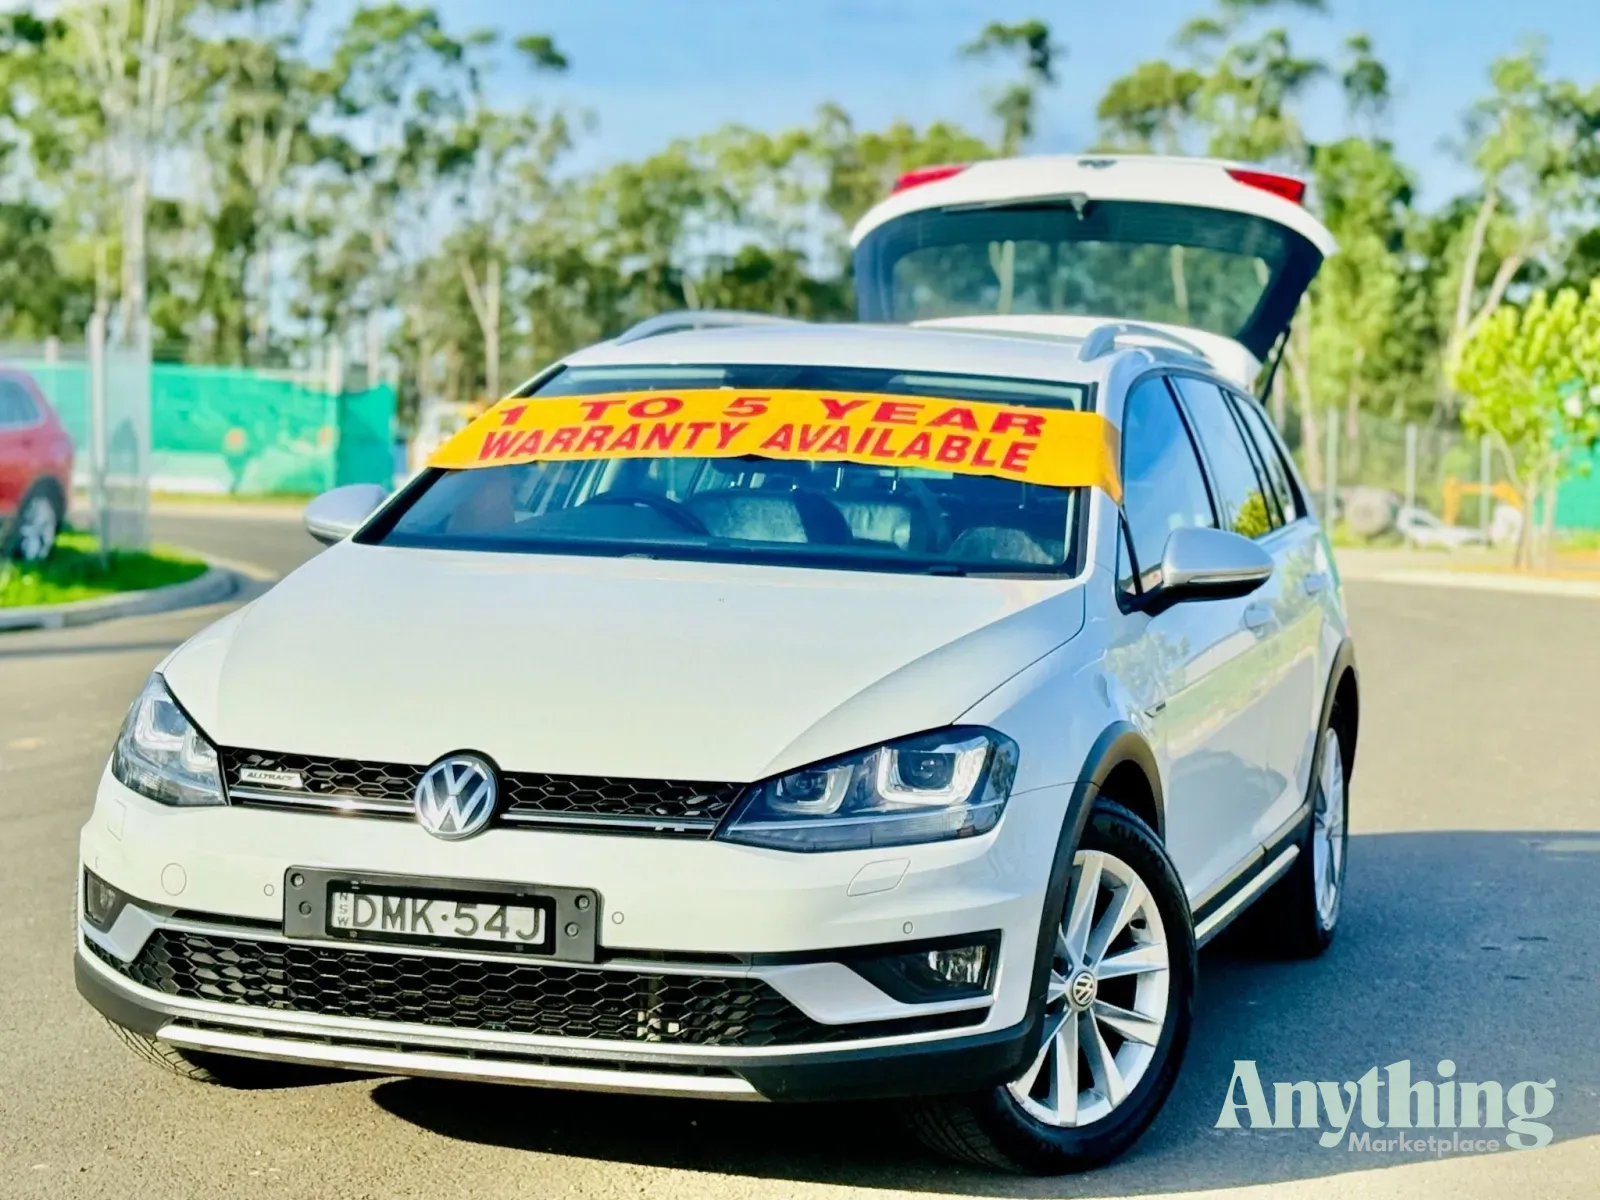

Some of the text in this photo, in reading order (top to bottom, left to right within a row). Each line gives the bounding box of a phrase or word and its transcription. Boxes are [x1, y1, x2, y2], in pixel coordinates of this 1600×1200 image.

[499, 396, 1047, 437] 1 TO 5 YEAR
[478, 421, 1037, 473] WARRANTY AVAILABLE
